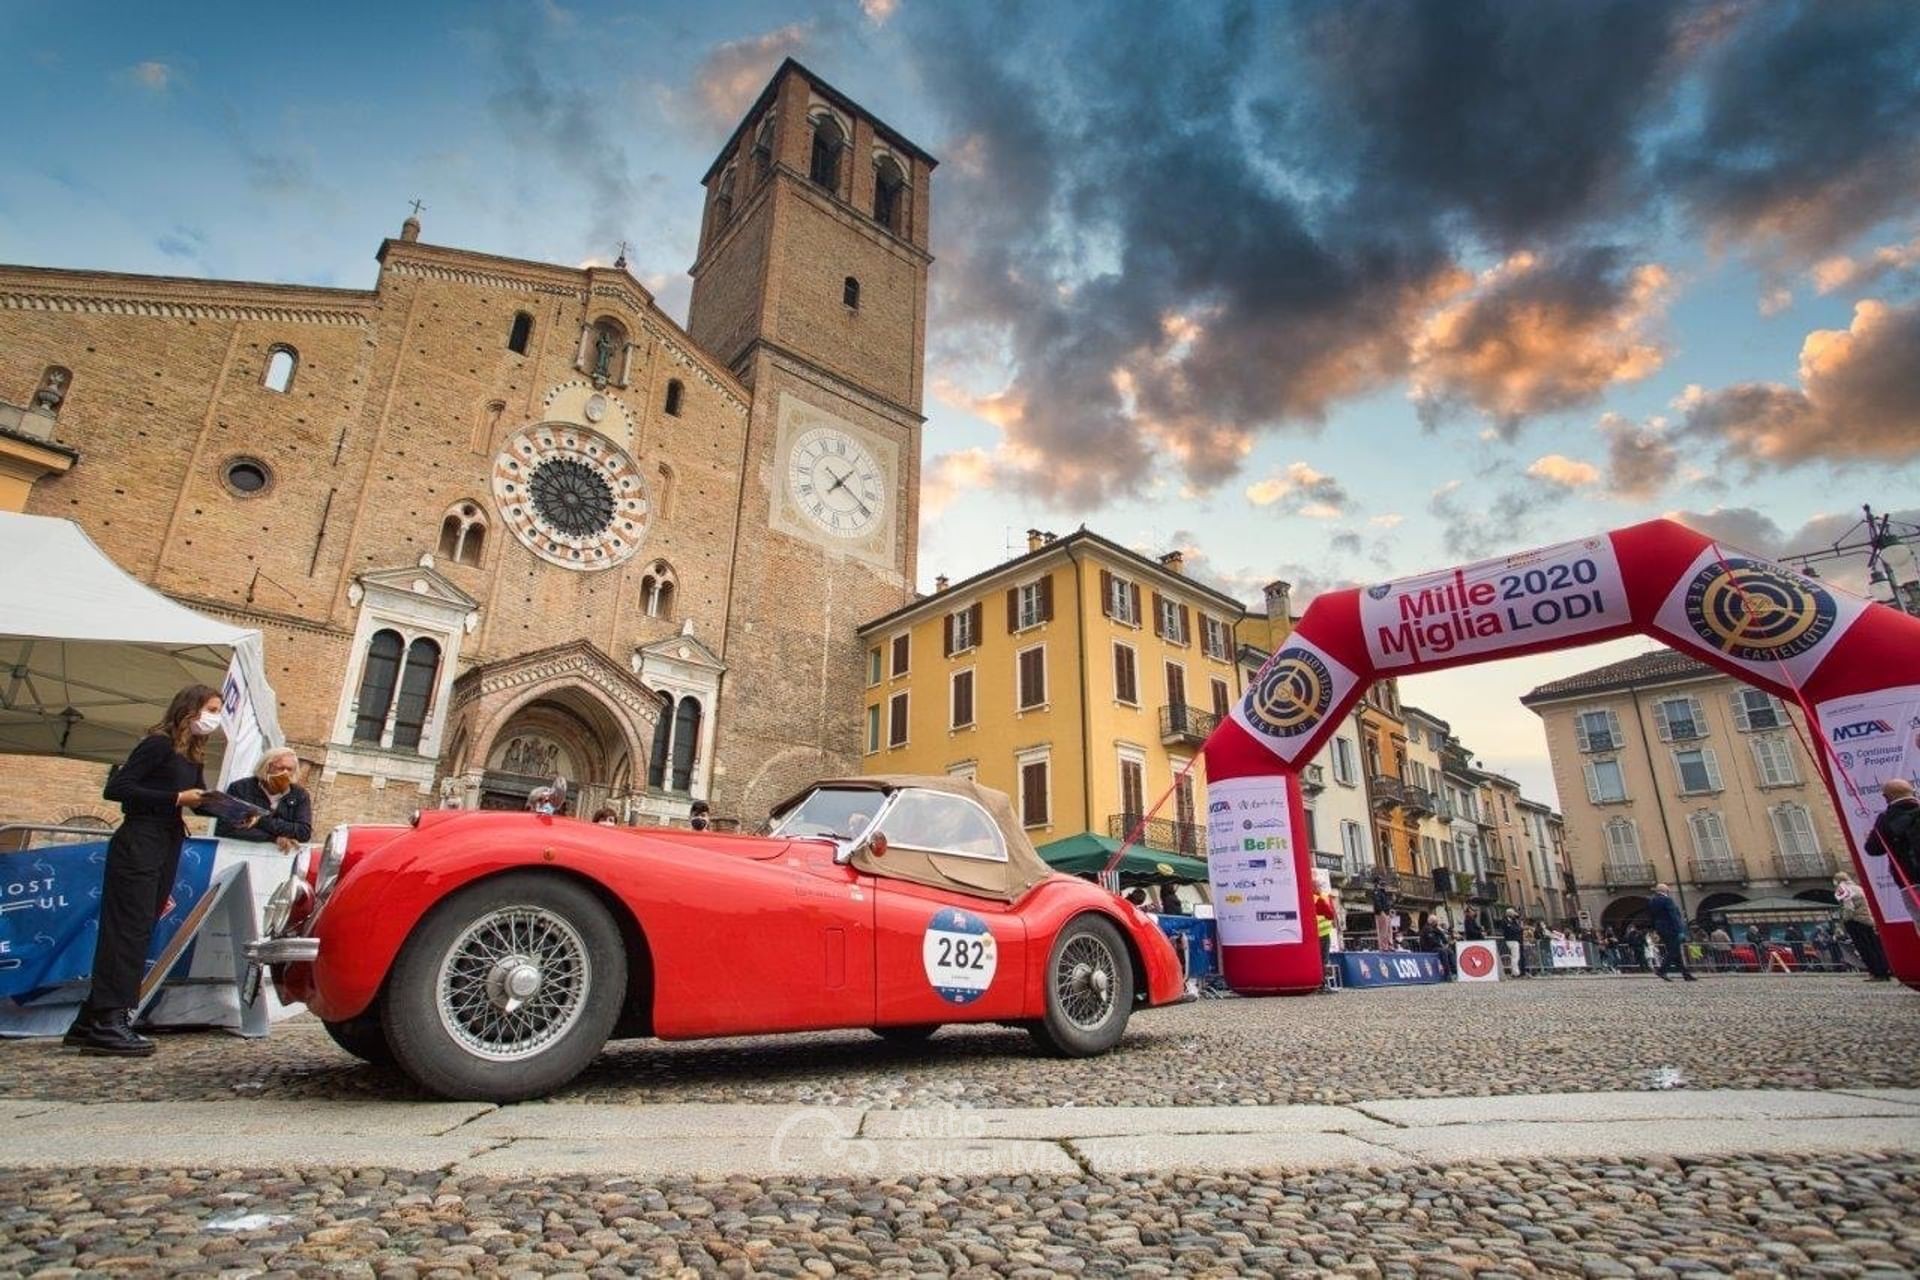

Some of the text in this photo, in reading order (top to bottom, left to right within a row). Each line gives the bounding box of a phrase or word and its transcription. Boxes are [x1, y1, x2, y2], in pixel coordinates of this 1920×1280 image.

[1399, 569, 1496, 620] Mille
[1500, 558, 1598, 600] 2020
[1378, 590, 1604, 664] Miglia LODI
[1743, 614, 1833, 661] CASTELLOTTI
[1246, 709, 1307, 736] EUGENIO
[1833, 720, 1885, 741] MTA
[1864, 754, 1903, 766] Properzi
[1244, 837, 1287, 851] BeFit
[0, 878, 55, 897] OST
[937, 937, 984, 969] 282
[1392, 958, 1422, 979] LODI
